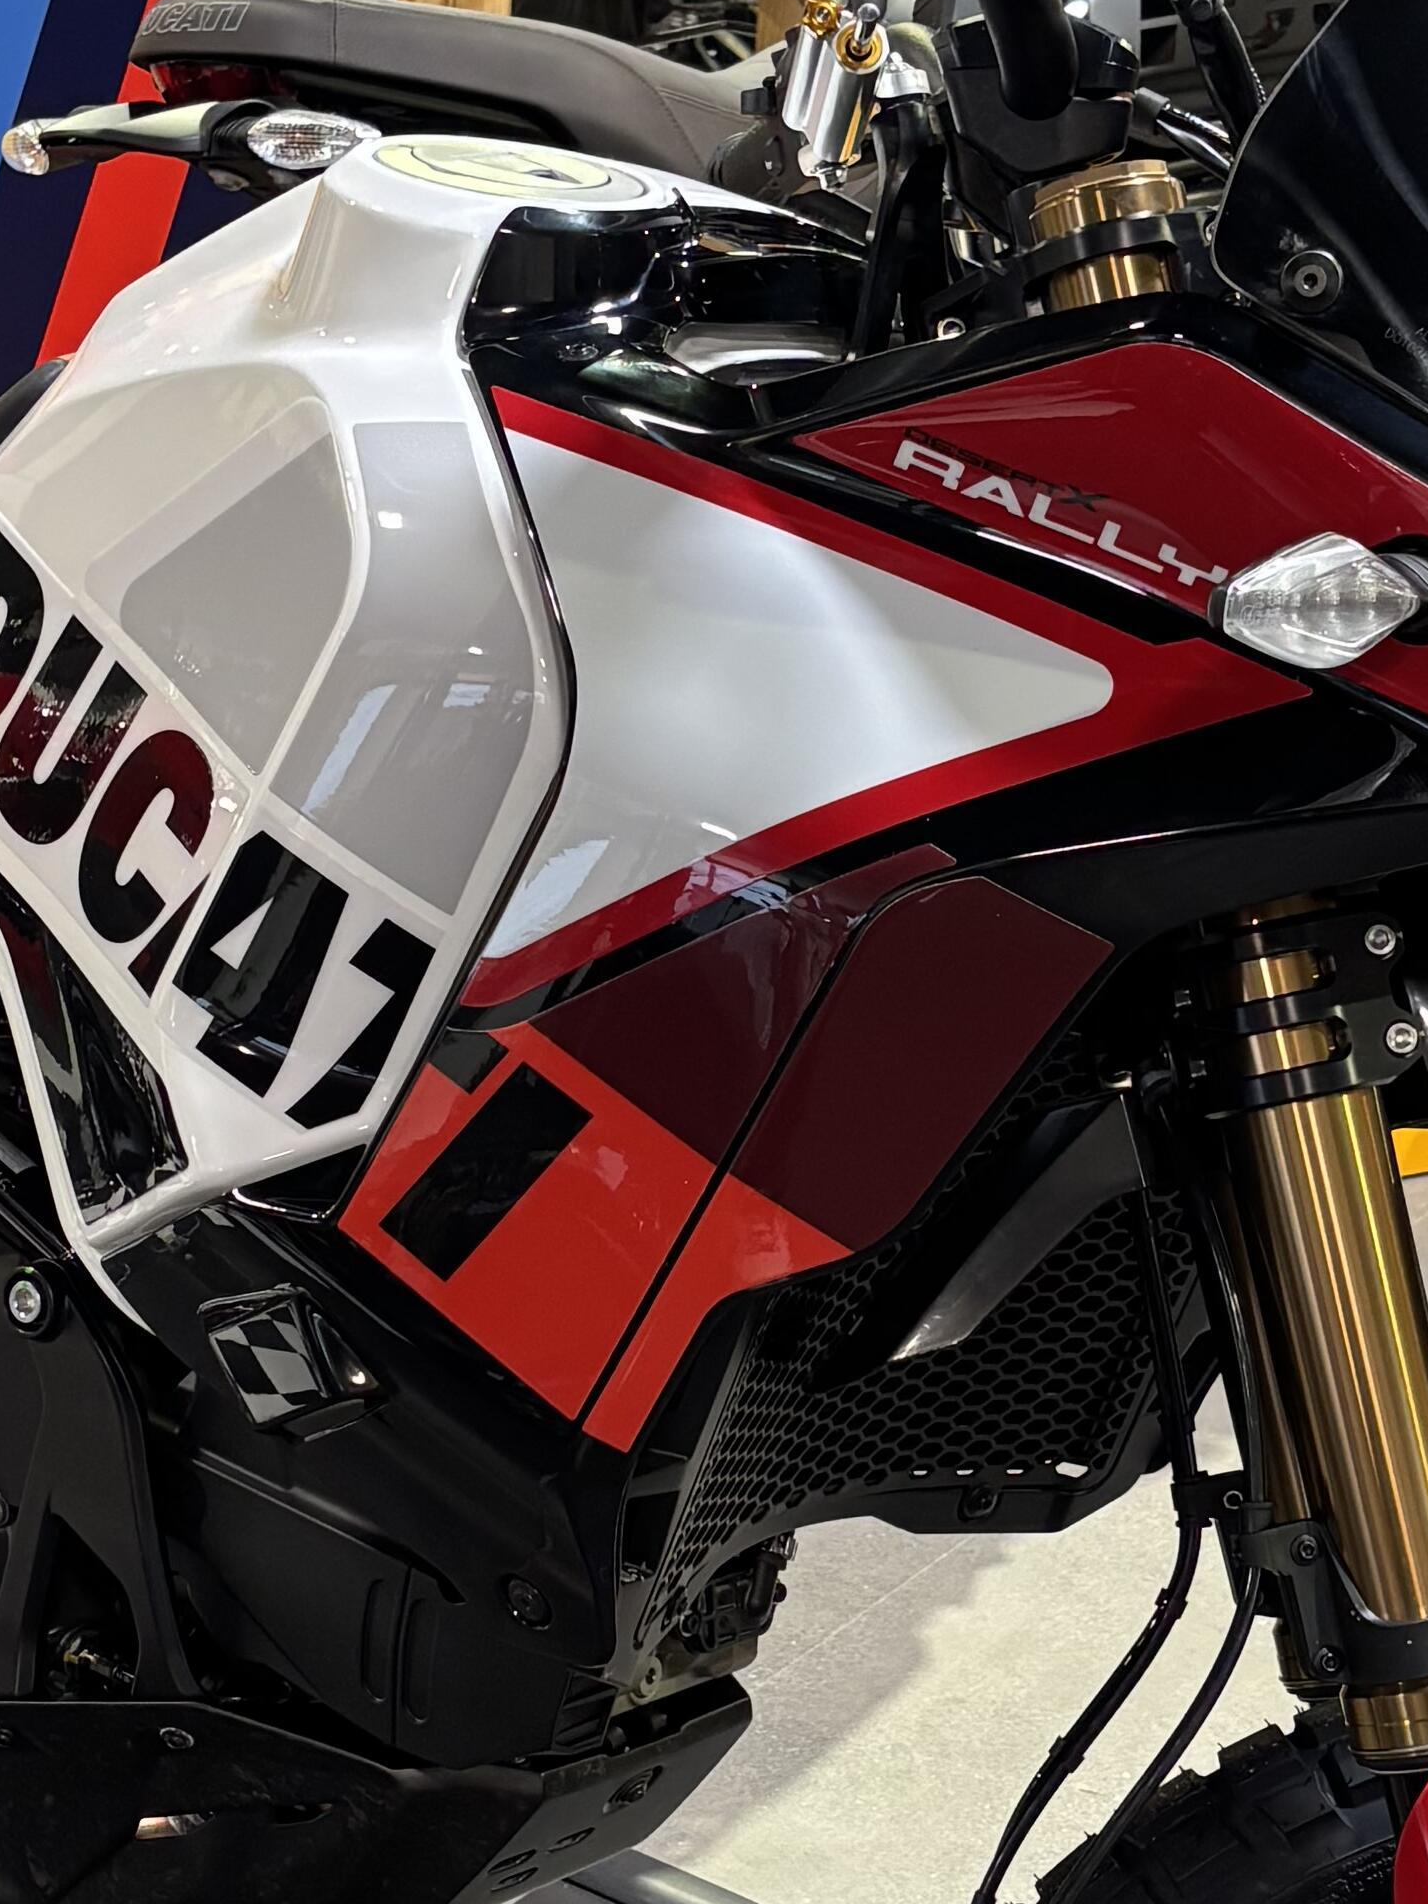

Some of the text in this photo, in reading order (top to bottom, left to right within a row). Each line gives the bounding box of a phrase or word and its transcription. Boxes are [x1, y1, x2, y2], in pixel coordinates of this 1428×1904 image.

[140, 1, 251, 36] UCATI
[903, 426, 1112, 512] DESERTX
[893, 439, 1229, 587] RALLY
